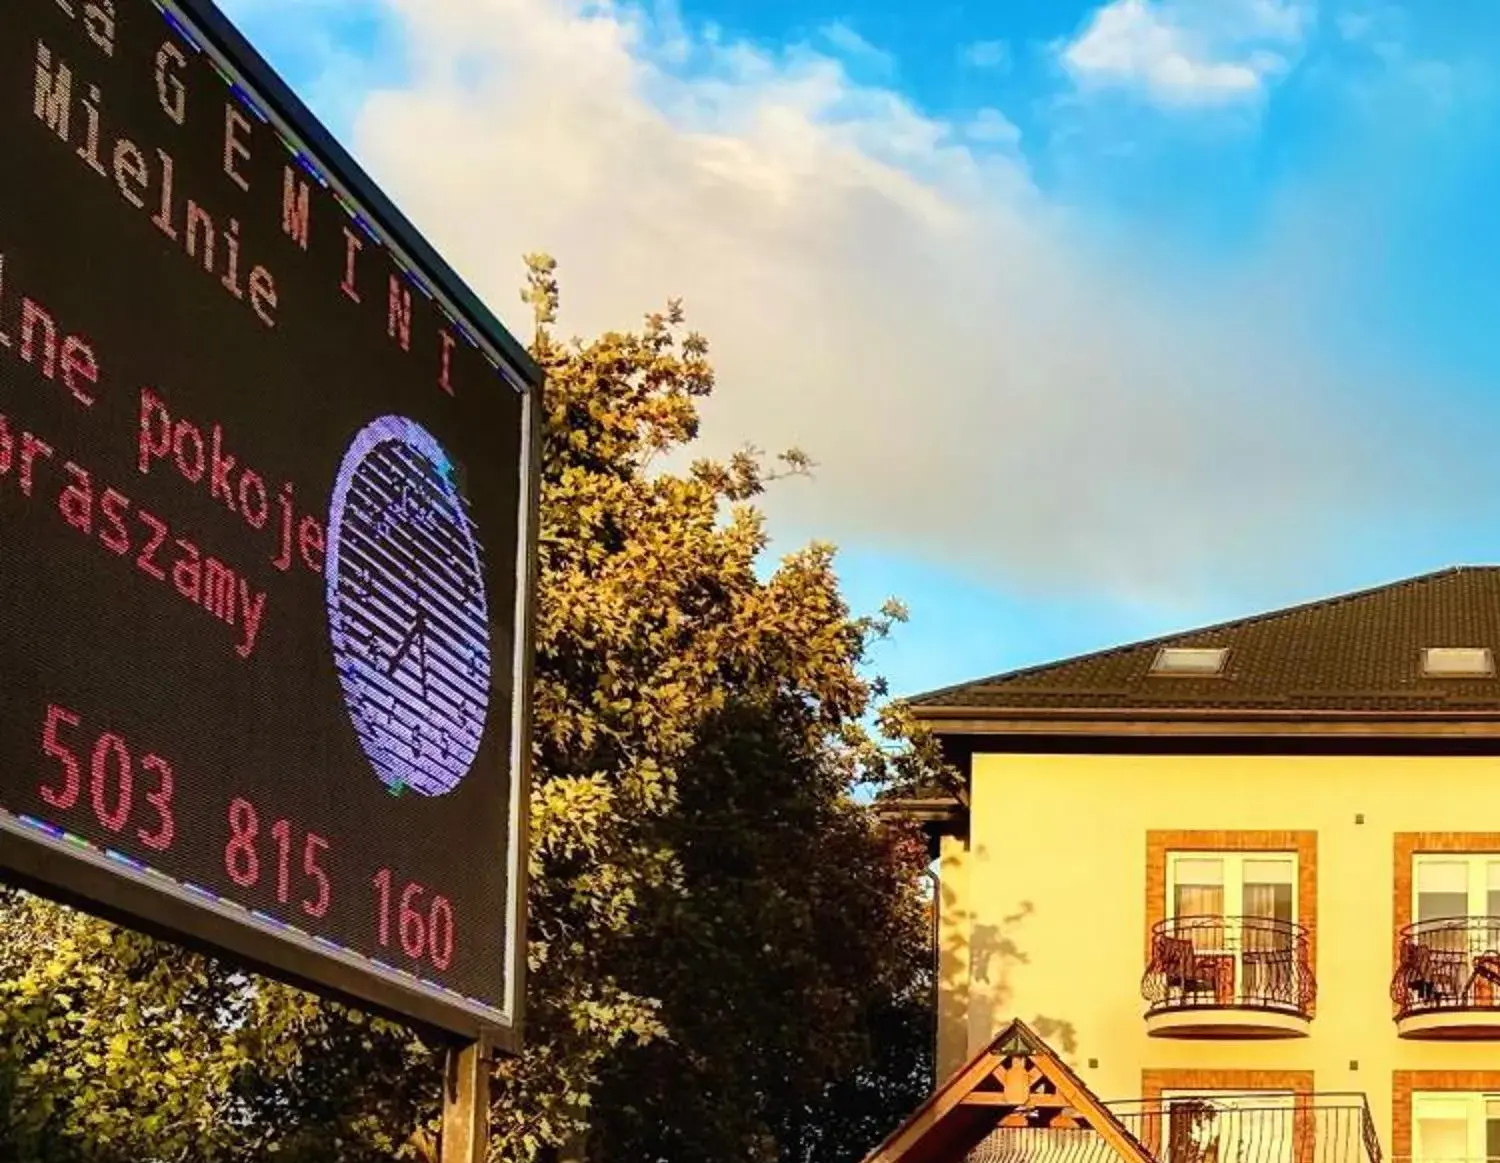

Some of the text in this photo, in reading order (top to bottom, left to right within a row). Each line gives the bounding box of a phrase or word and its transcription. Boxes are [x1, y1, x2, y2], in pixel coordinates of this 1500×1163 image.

[33, 37, 278, 328] Mielnie
[138, 386, 326, 572] pokoje
[39, 703, 456, 971] 503 815 160
